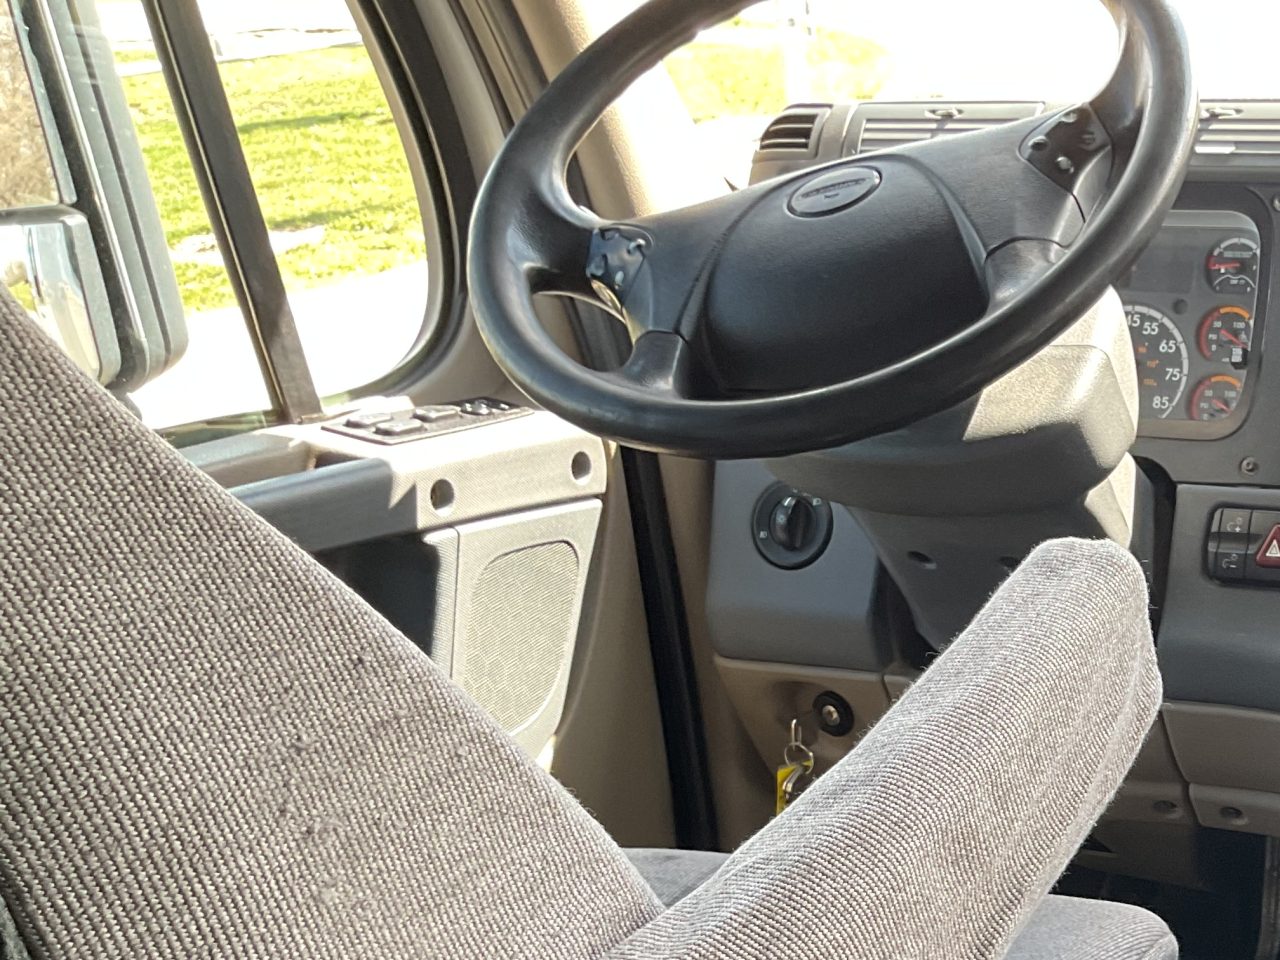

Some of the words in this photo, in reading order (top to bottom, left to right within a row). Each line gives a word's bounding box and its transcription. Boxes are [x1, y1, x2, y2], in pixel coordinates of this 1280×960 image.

[1142, 322, 1159, 335] 55
[1159, 340, 1176, 353] 65
[1165, 368, 1181, 381] 75
[1152, 396, 1169, 409] 85
